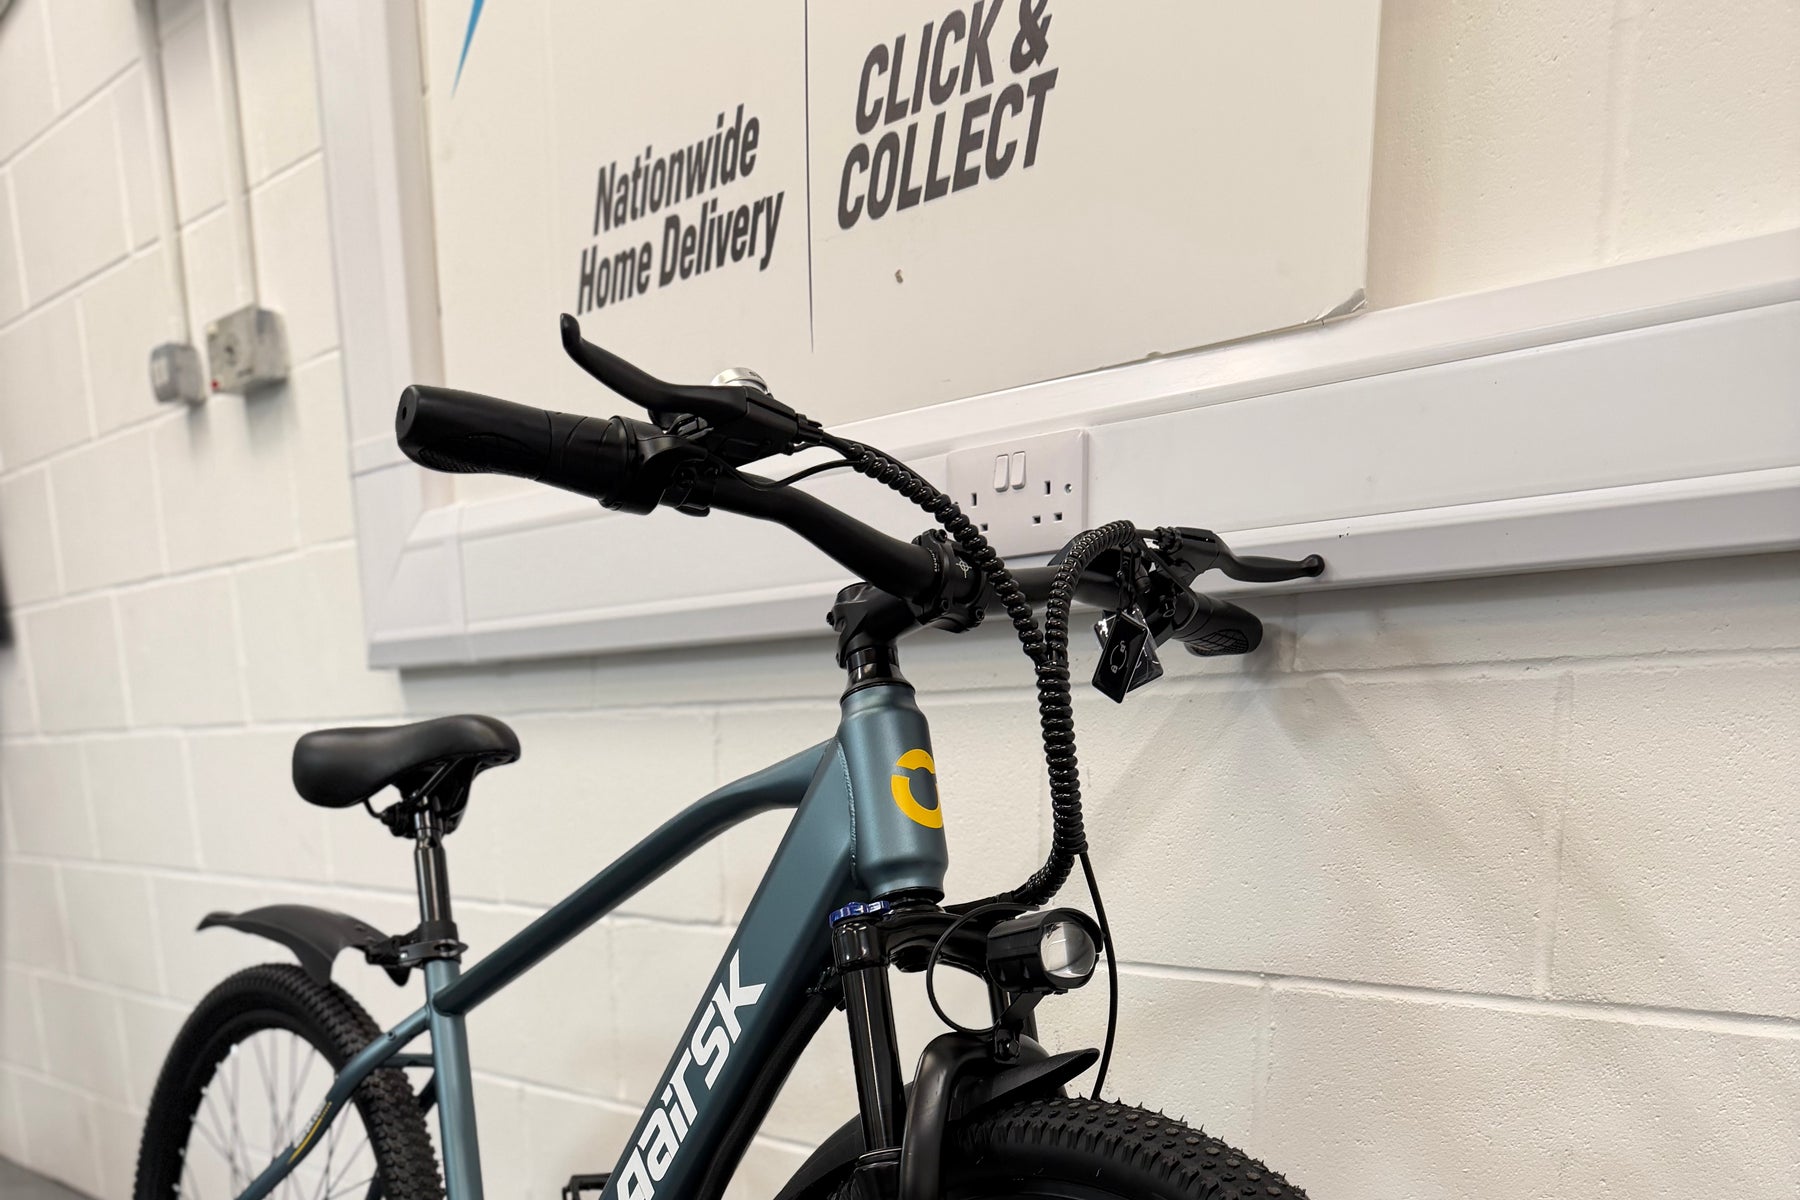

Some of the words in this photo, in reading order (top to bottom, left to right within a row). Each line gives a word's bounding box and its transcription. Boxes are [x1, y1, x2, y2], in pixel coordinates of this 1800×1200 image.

[856, 0, 1003, 135] CLICK
[1009, 0, 1053, 74] &
[593, 103, 760, 236] Nationwide
[837, 67, 1059, 230] COLLECT
[575, 242, 653, 316] Home
[658, 191, 785, 288] Delivery
